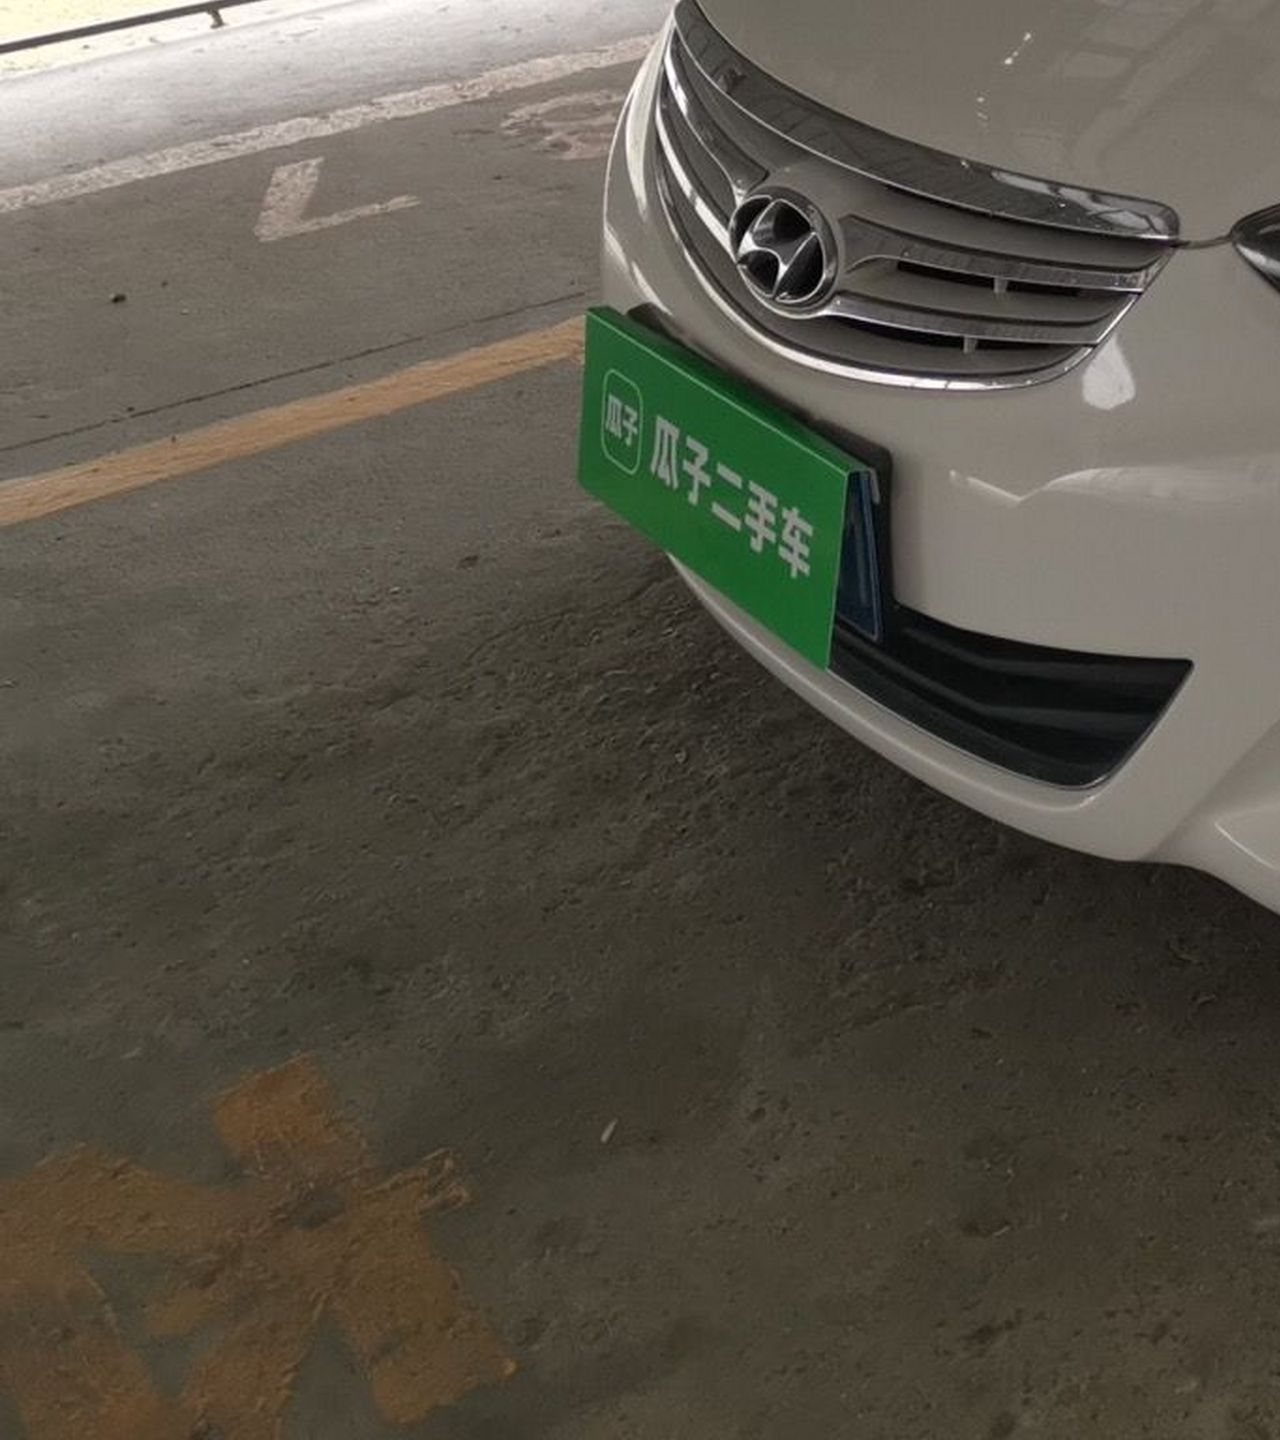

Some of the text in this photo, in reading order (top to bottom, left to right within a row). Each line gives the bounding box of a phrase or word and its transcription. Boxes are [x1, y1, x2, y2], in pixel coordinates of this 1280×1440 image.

[605, 393, 639, 447] 瓜子
[651, 415, 814, 579] 瓜子二手车
